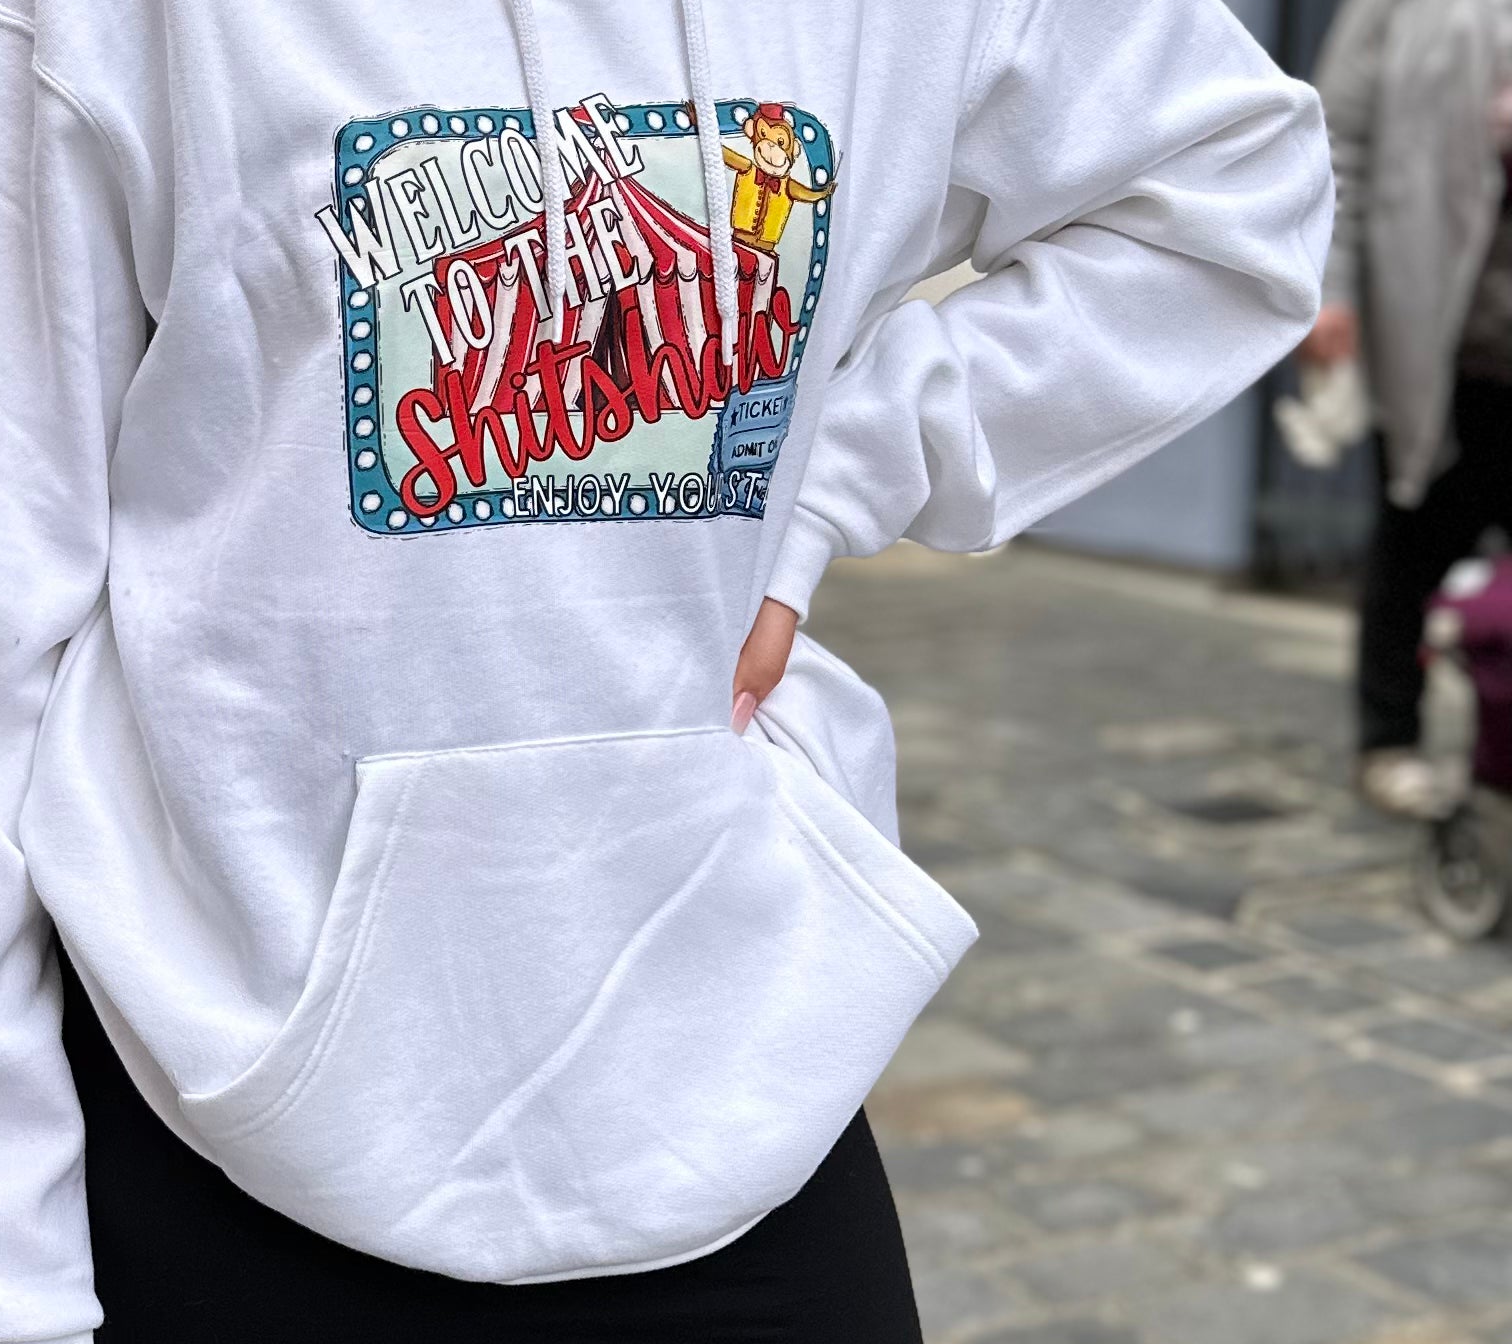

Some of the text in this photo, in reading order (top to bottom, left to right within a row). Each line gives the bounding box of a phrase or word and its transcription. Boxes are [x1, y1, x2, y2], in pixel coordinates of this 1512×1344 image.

[314, 93, 645, 290] WELCOME
[400, 196, 645, 366] TO THE
[511, 472, 629, 517] ENJOY
[648, 471, 724, 515] YOU
